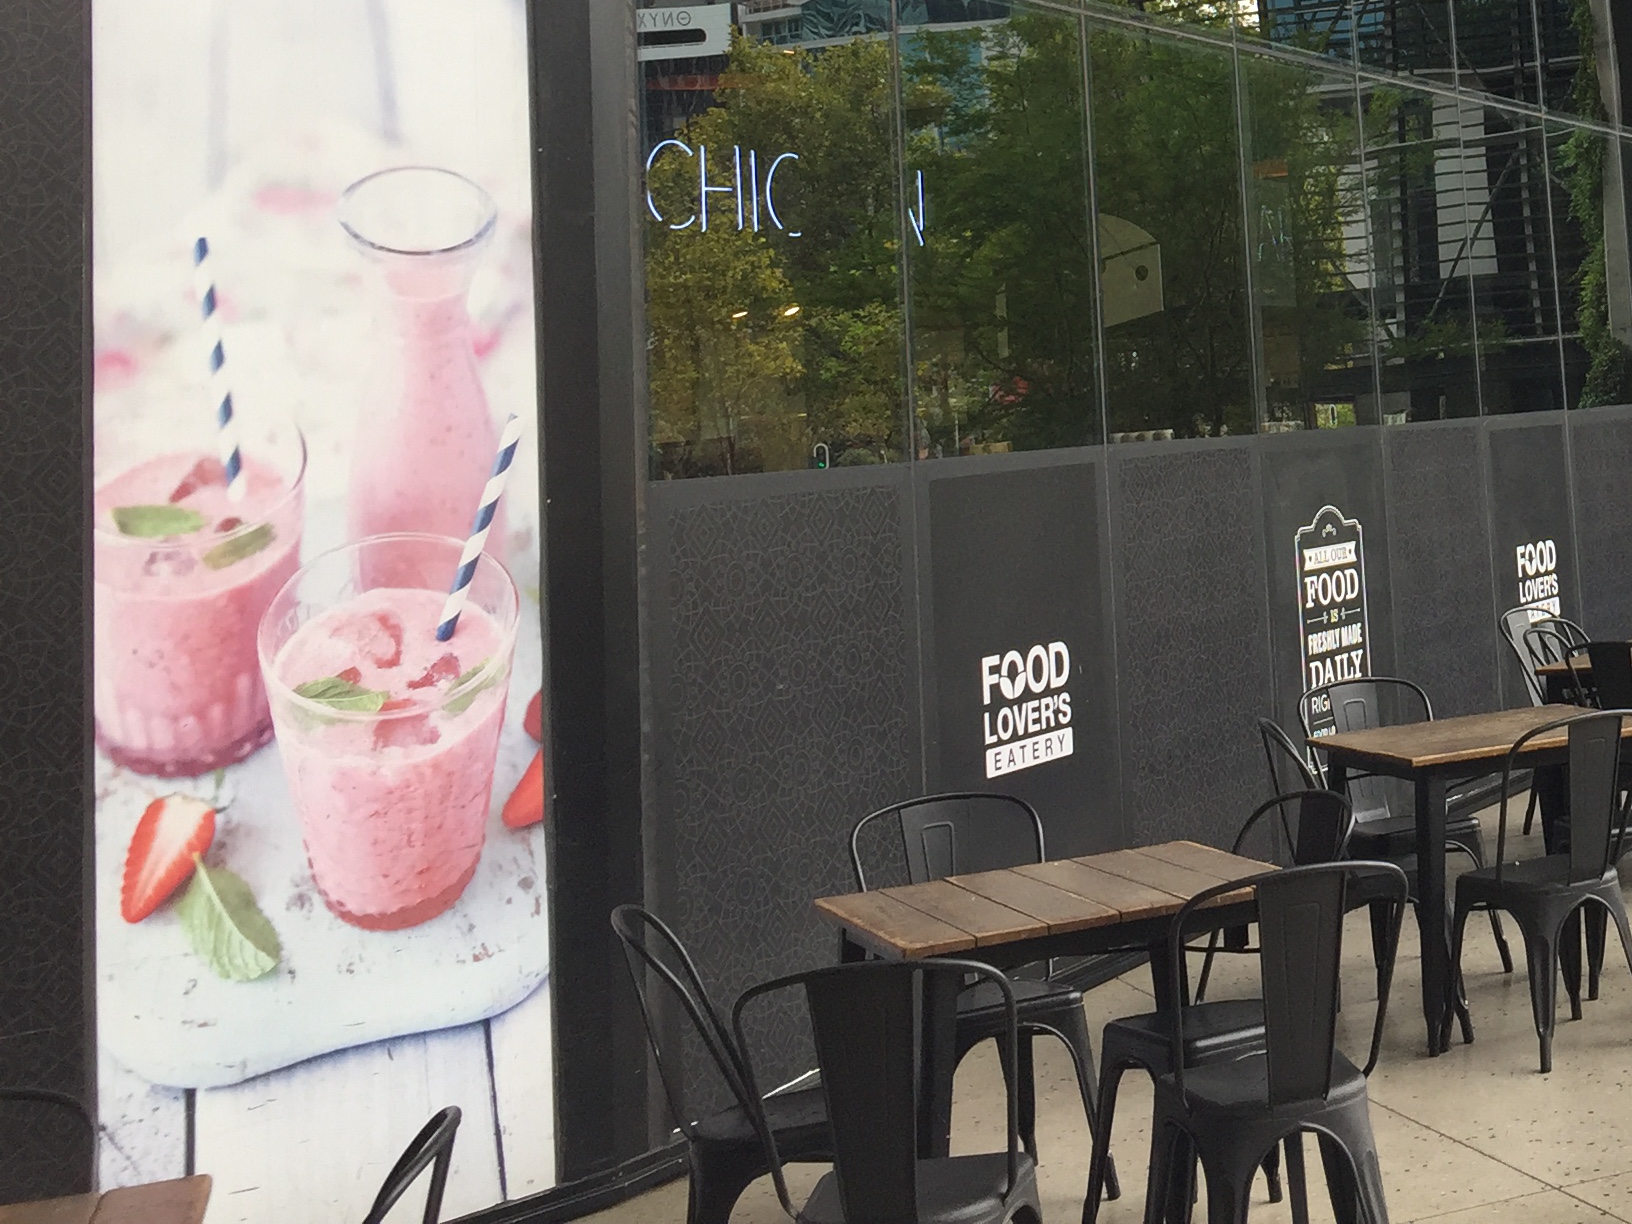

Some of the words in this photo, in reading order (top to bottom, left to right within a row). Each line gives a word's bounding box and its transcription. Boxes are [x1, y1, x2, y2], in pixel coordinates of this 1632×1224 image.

[1516, 539, 1557, 578] FOOD
[1303, 568, 1359, 609] FOOD
[1307, 627, 1340, 656] FRESHLY
[1341, 622, 1363, 647] MADE
[981, 641, 1070, 706] FOOD
[1309, 648, 1364, 690] DAILY
[984, 692, 1072, 745] LOVER'S
[993, 733, 1066, 772] EATERY
